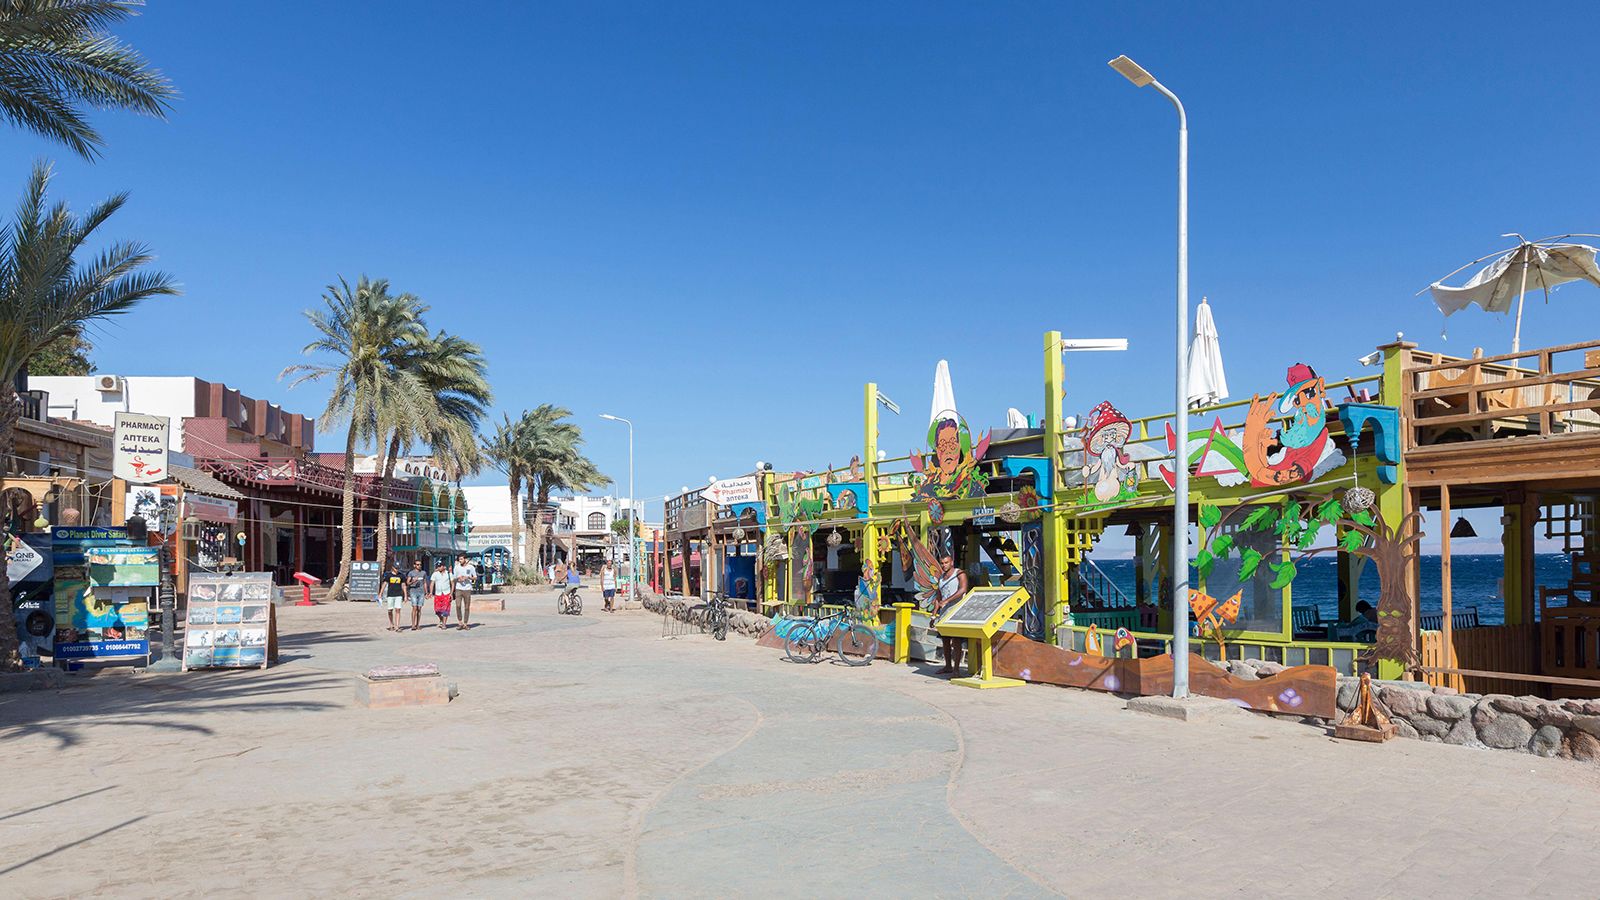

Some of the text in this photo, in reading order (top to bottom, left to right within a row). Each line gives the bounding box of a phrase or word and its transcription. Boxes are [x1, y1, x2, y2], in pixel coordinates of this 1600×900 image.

[120, 421, 165, 431] PHARMACY
[123, 434, 160, 443] АПТЕКА
[120, 443, 163, 456] صيدلية
[70, 530, 90, 539] Planet
